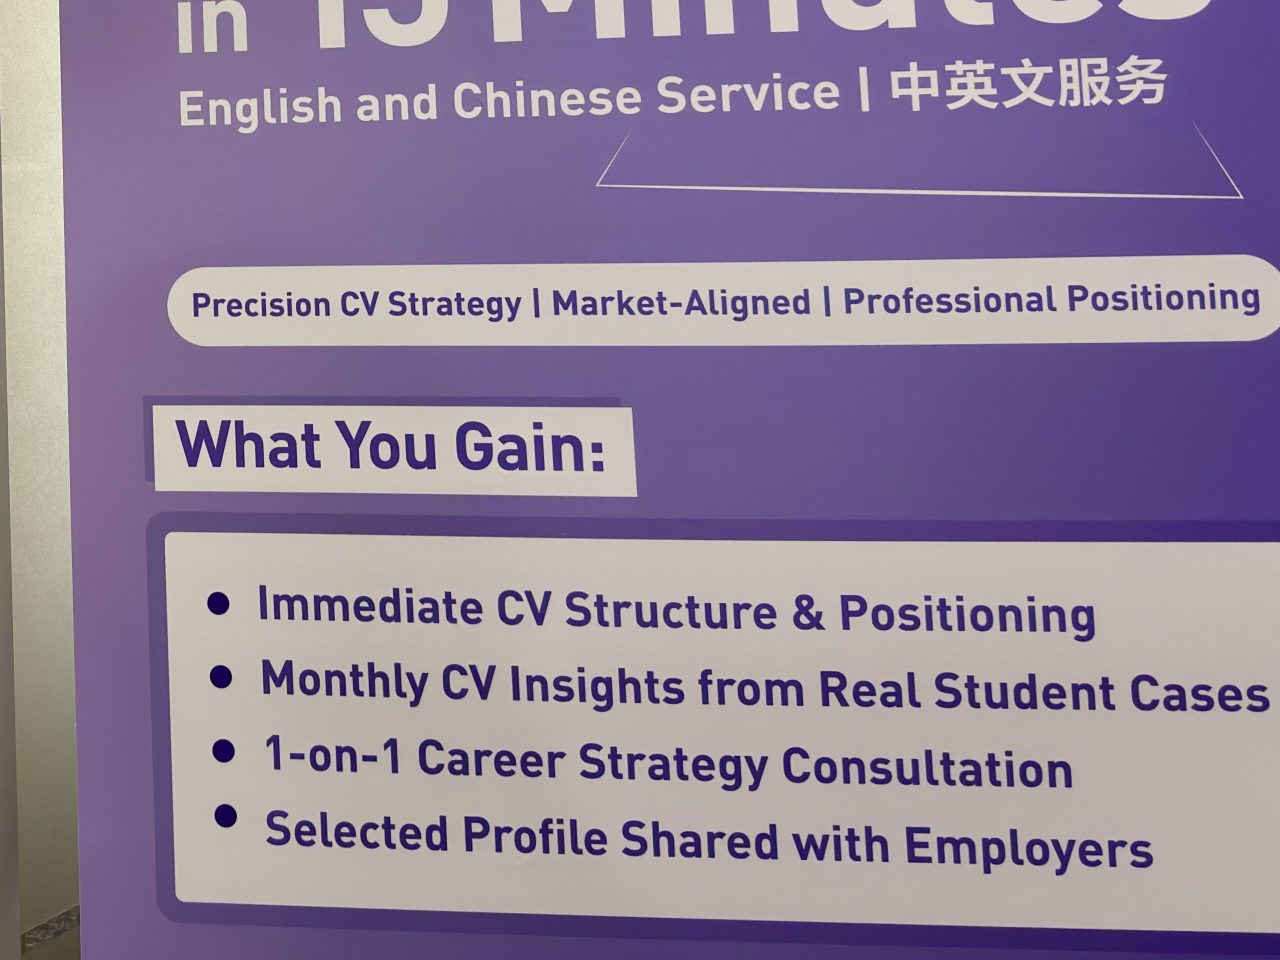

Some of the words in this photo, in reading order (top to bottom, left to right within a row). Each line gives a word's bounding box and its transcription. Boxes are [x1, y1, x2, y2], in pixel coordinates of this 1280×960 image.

[178, 84, 342, 136] English
[352, 81, 438, 123] and
[453, 78, 641, 119] Chinese
[656, 72, 840, 114] Service
[890, 55, 1167, 112] 中英文服务
[193, 290, 330, 317] Precision
[342, 291, 378, 317] CV
[389, 291, 521, 323] Strategy
[553, 288, 810, 321] Market-Aligned
[844, 286, 1056, 314] Professional
[1068, 284, 1261, 316] Positioning
[176, 420, 320, 468] What
[336, 421, 436, 469] You
[456, 421, 606, 471] Gain:
[259, 586, 482, 624] Immediate
[498, 590, 551, 625] CV
[566, 592, 777, 629] Structure
[793, 594, 823, 630] &
[840, 595, 1095, 642] Positioning
[262, 660, 427, 707] Monthly
[444, 664, 496, 699] CV
[512, 666, 684, 712] Insights
[699, 669, 803, 706] from
[820, 671, 920, 708] Real
[935, 672, 1115, 710] Student
[1132, 674, 1270, 713] Cases
[267, 736, 398, 773] 1-on-1
[419, 740, 565, 778] Career
[580, 743, 767, 791] Strategy
[783, 747, 1072, 788] Consultation
[267, 811, 448, 851] Selected
[464, 816, 608, 855] Profile
[622, 821, 778, 860] Shared
[792, 826, 888, 863] with
[906, 826, 1153, 876] Employers
